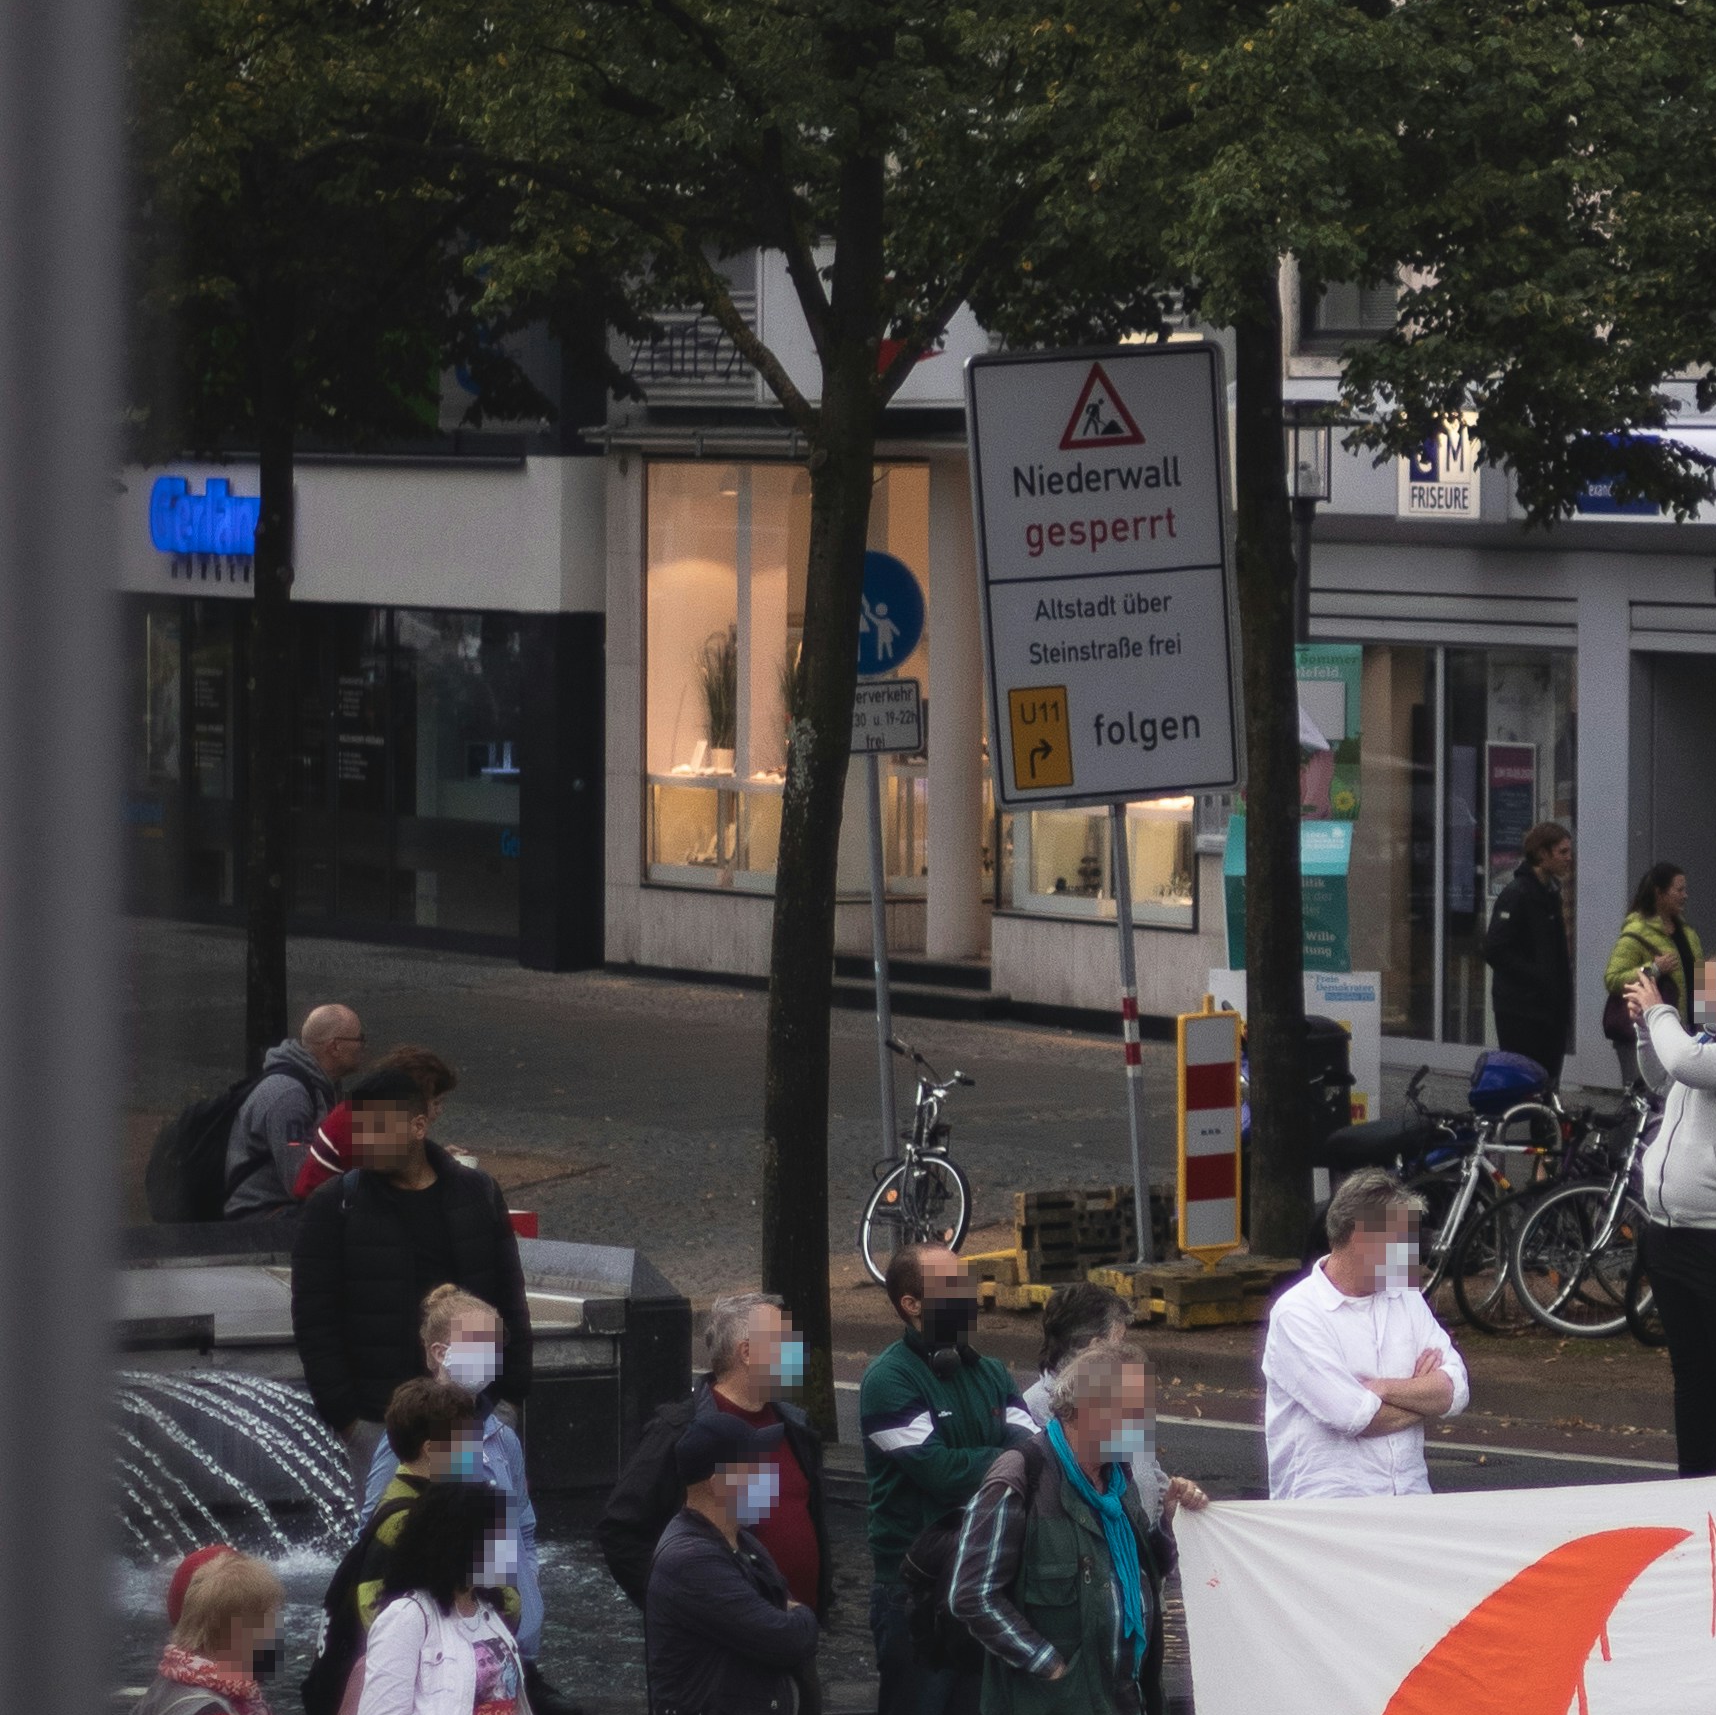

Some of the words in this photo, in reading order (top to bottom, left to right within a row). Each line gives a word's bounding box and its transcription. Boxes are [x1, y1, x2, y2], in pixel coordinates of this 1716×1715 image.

[1012, 457, 1181, 498] Niederwall
[1410, 485, 1469, 509] FRISEURE
[1025, 507, 1177, 558] gesperrt
[1035, 594, 1116, 621] Altstadt
[1123, 591, 1172, 615] über
[1029, 637, 1143, 665] Steinstraße
[1149, 632, 1181, 657] frei
[856, 686, 913, 704] erverkehr
[1020, 700, 1060, 726] U11
[1093, 711, 1200, 752] folgen
